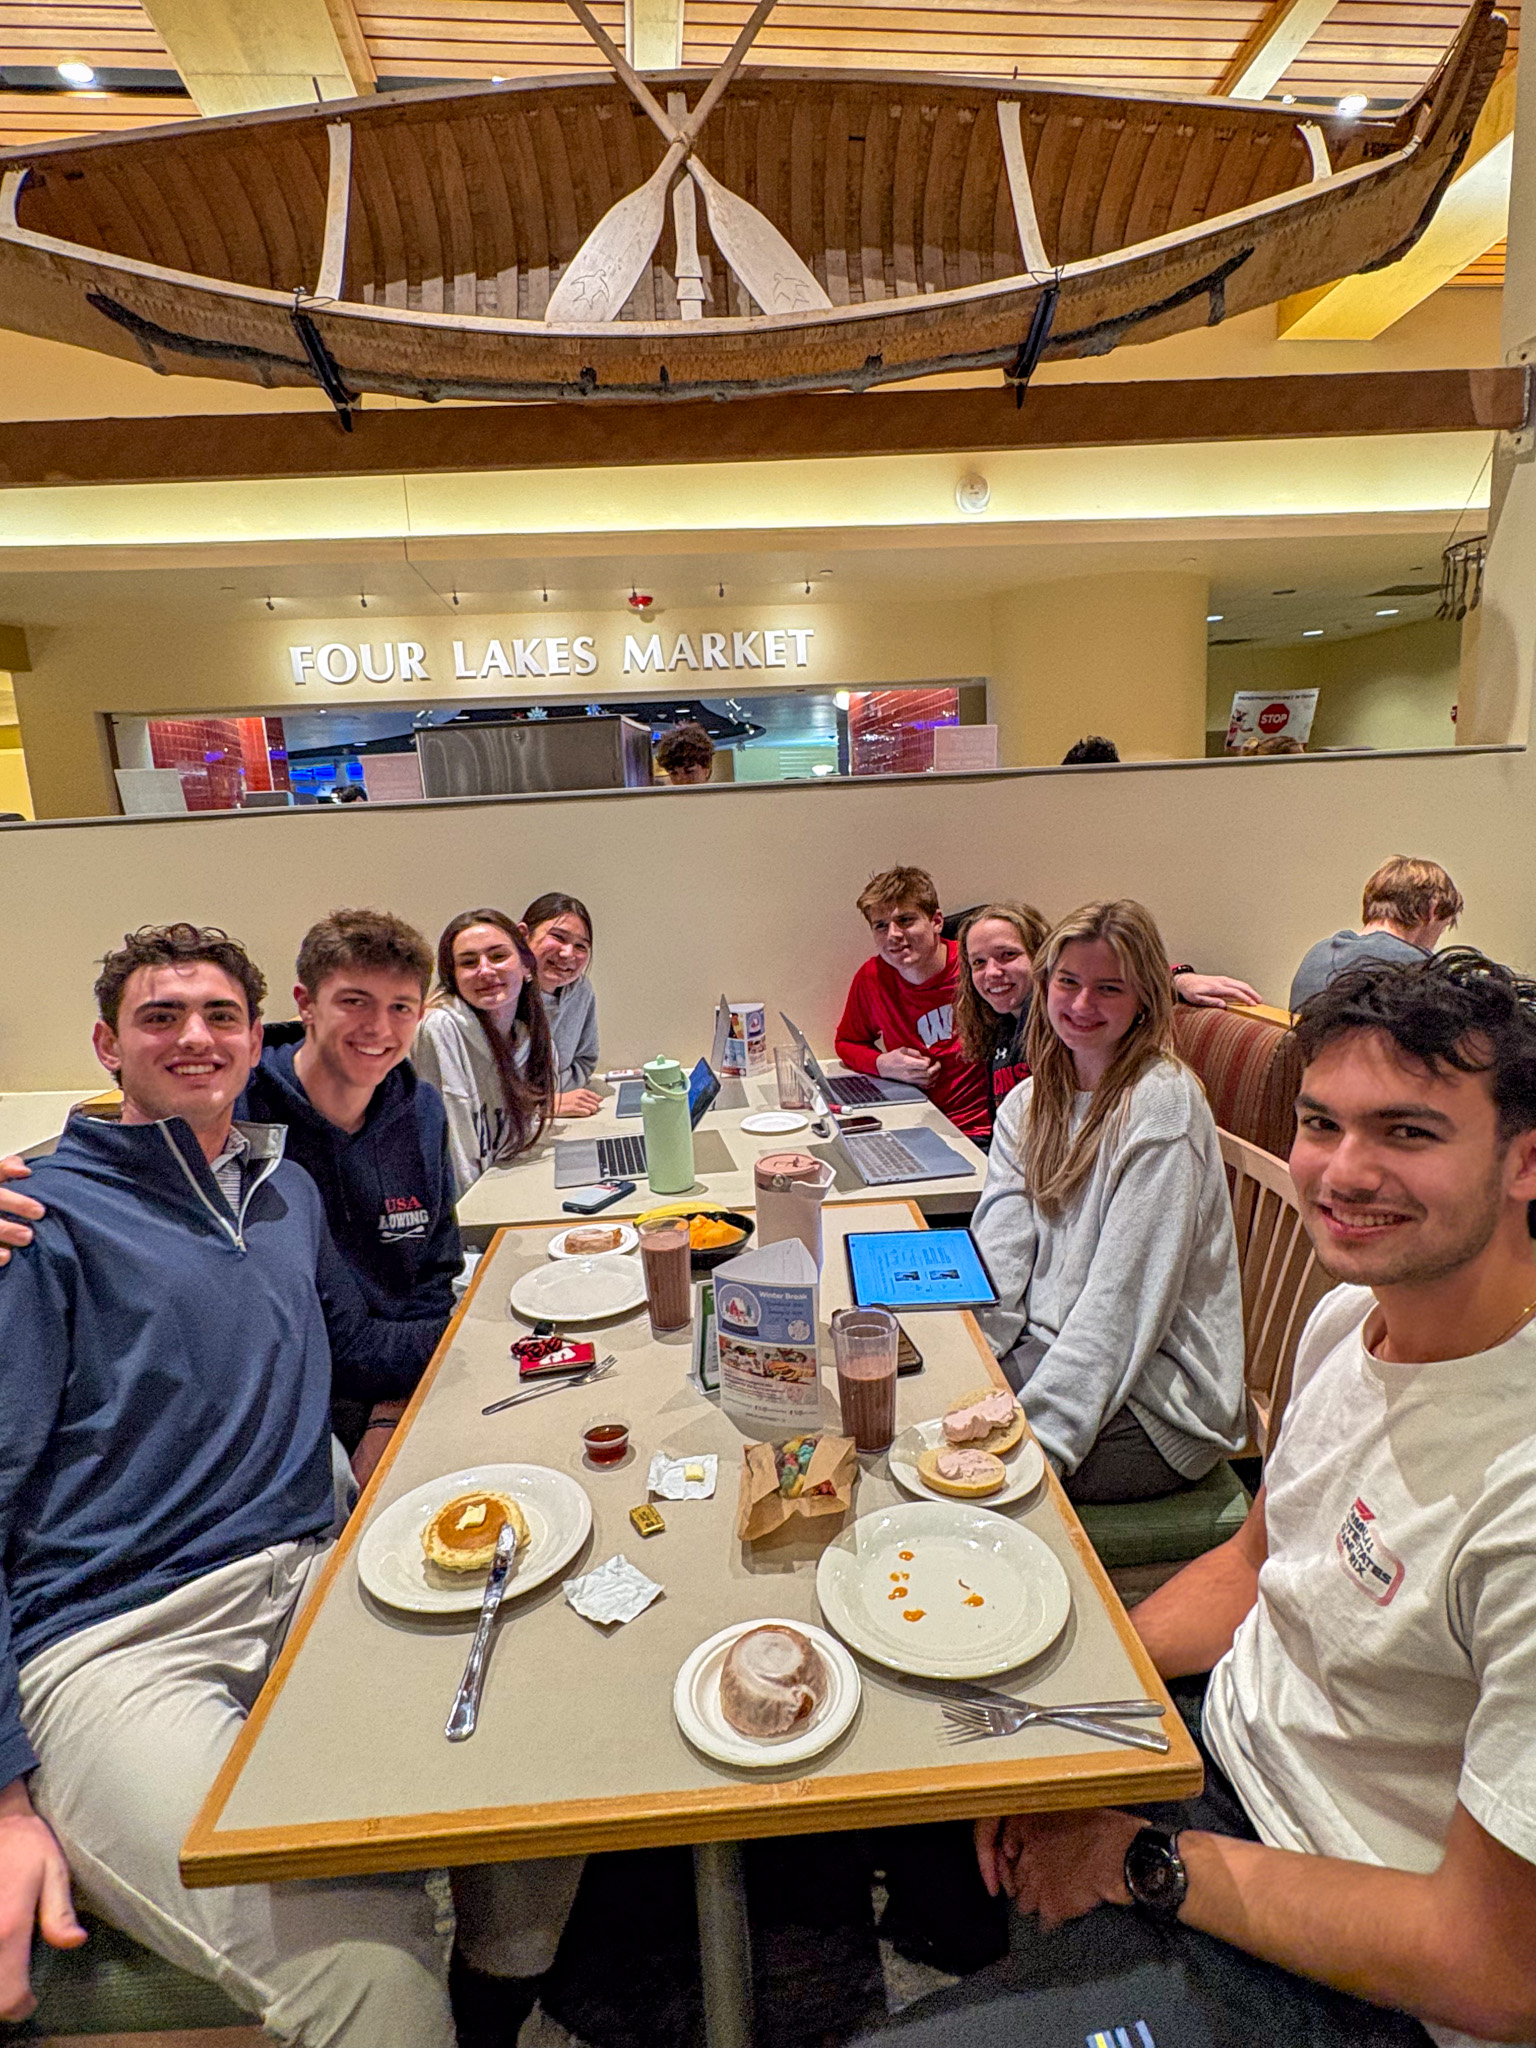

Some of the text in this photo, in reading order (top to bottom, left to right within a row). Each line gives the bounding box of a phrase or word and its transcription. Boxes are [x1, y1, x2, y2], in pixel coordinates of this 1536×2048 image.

[289, 629, 814, 686] FOUR LAKES MARKET
[1260, 713, 1288, 725] STOP
[917, 1003, 954, 1049] W
[385, 1195, 422, 1213] USA
[758, 1291, 784, 1300] Winter
